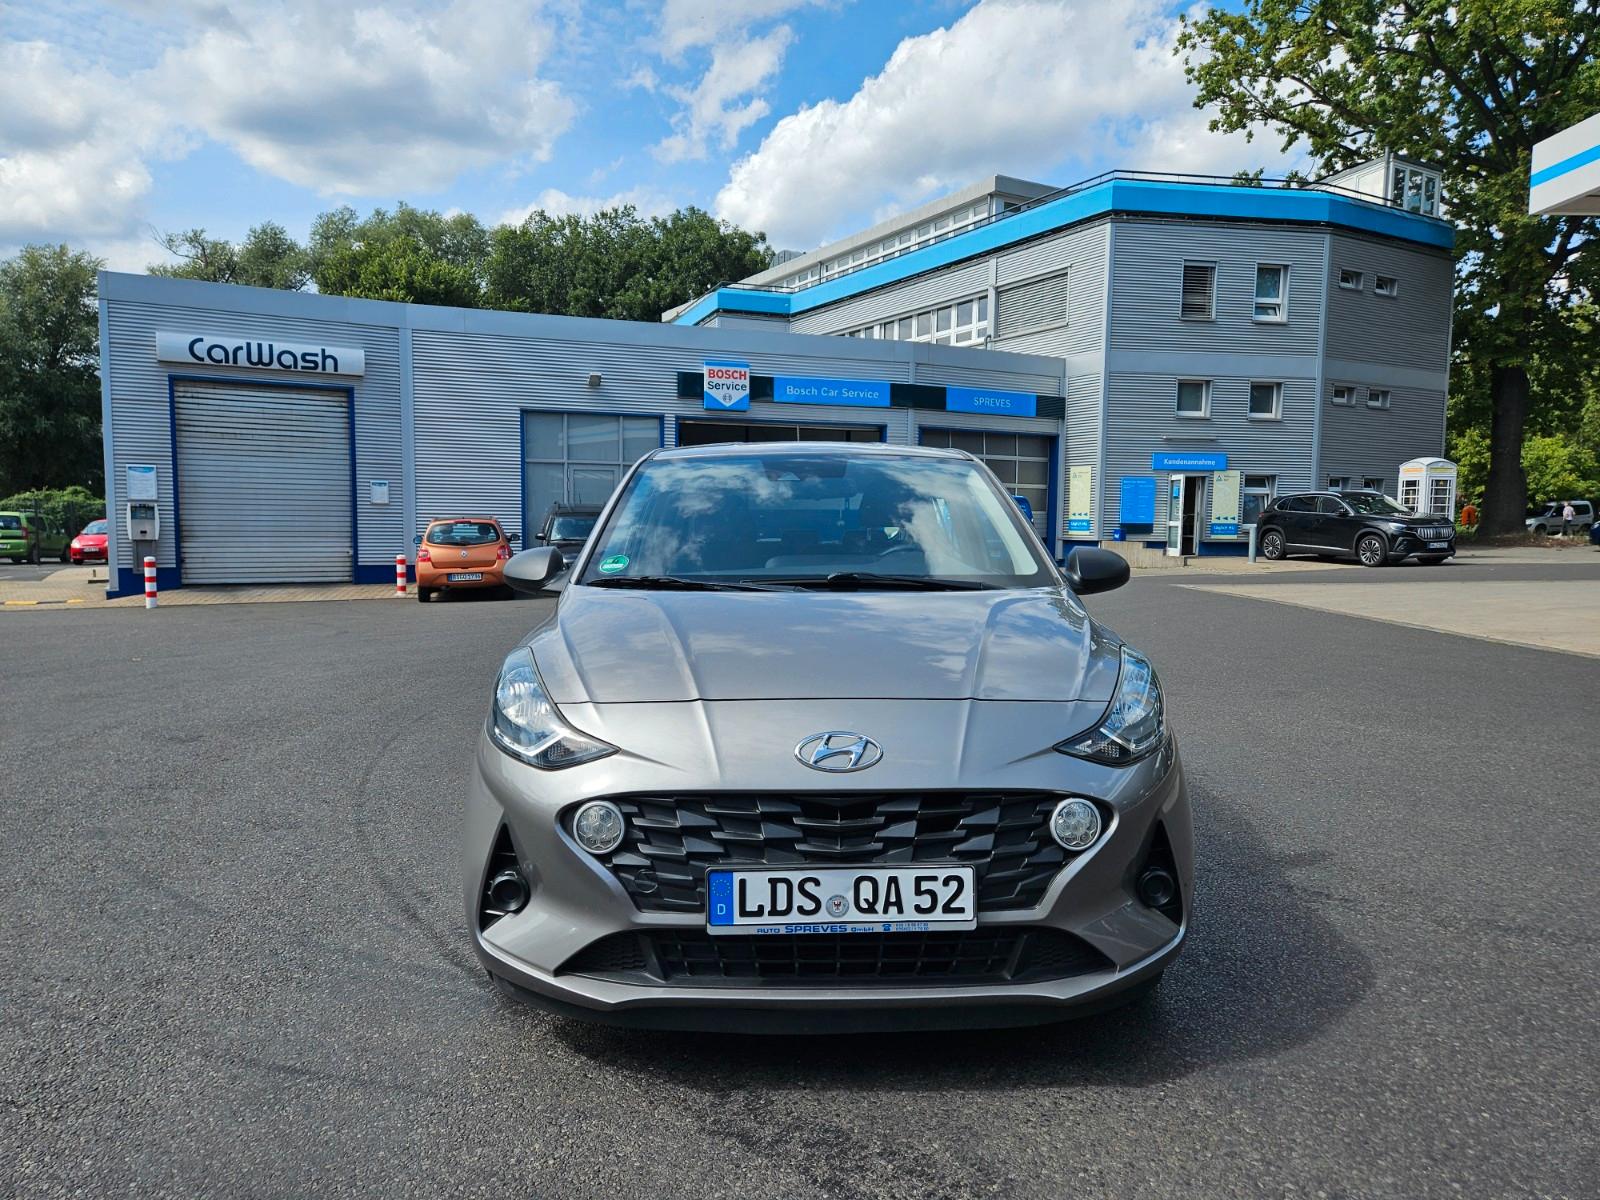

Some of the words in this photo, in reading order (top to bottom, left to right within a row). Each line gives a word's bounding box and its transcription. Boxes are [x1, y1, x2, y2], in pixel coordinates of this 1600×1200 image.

[188, 337, 339, 373] CarWash
[707, 368, 747, 381] BOSCH
[707, 380, 747, 391] Service
[786, 385, 818, 397] Bosch
[820, 387, 838, 398] Car
[841, 388, 880, 399] Service
[973, 396, 1012, 408] SPREVES
[1163, 457, 1216, 466] Kundenannahme
[717, 903, 726, 915] D
[738, 876, 822, 918] LDS
[853, 875, 904, 915] QA
[913, 874, 966, 915] 52
[784, 924, 848, 934] SPREVES
